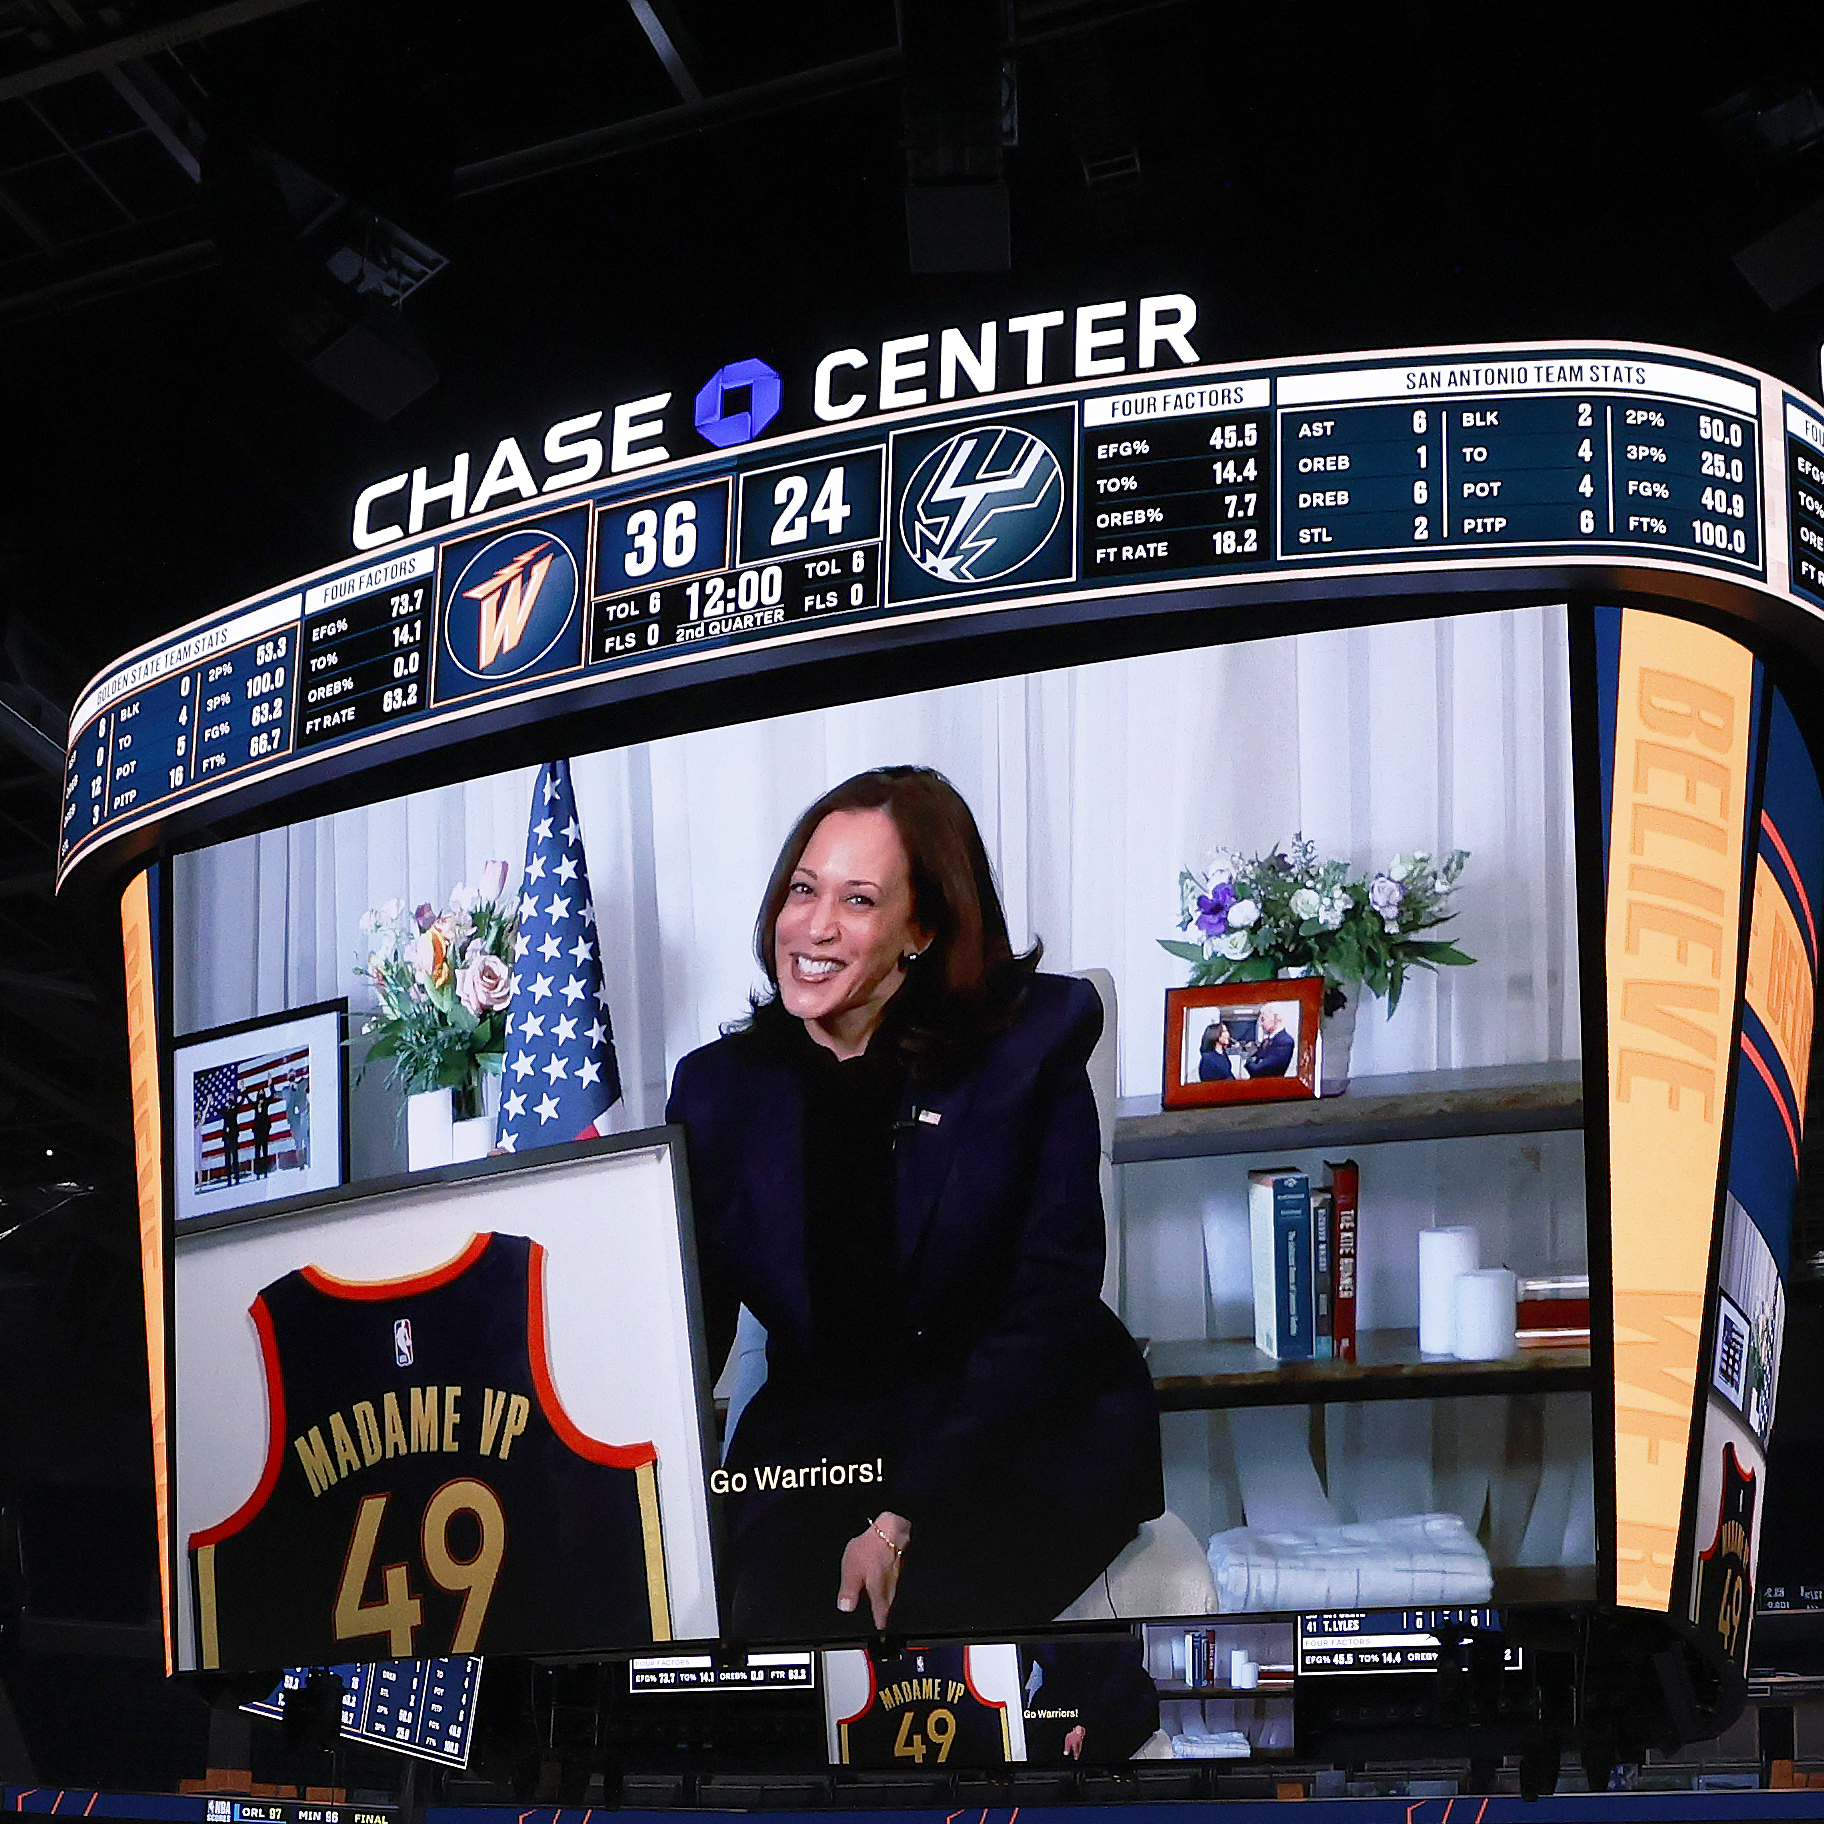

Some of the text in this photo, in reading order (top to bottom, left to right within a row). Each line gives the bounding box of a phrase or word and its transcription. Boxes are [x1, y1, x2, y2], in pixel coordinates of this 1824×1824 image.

[814, 293, 1200, 421] CENTER
[1406, 365, 1645, 390] SAN ANTONIO TEAM STATS
[1111, 387, 1244, 418] FOUR FACTORS
[1462, 403, 1592, 427] BLK 2
[1097, 424, 1257, 459] EFG% 45.5
[1299, 411, 1427, 438] AST 6
[1626, 409, 1742, 448] 2P% 50.0
[1299, 445, 1427, 473] OREB 1
[1462, 439, 1592, 462] TO 4
[1626, 445, 1743, 483] 3P% 25.0
[353, 392, 672, 551] CHASE
[1097, 458, 1257, 493] TO% 14.4
[1463, 474, 1593, 498] POT 4
[771, 467, 850, 546] 24
[1096, 493, 1257, 528] OREB% 7.7
[1299, 481, 1428, 508] DREB 6
[1628, 481, 1744, 518] FG% 40.9
[624, 501, 697, 577] 36
[1299, 517, 1428, 544] STL 2
[1463, 510, 1594, 534] PITP 6
[1629, 517, 1745, 554] FT% 100.0
[1096, 529, 1257, 563] FT RATE 18.2
[324, 558, 415, 604] FOUR FACTORS
[805, 552, 864, 579] TOL 6
[606, 593, 661, 621] TOL 6
[685, 567, 782, 620] 12:00
[804, 585, 862, 611] FLS 0
[312, 590, 423, 641] EFG% 73.7
[676, 608, 784, 642] 2nd QUARTER
[310, 621, 420, 671] TO% 14.1
[605, 625, 659, 654] FLS 0
[97, 629, 227, 705] GOLDEN STATE TEAM STATS
[208, 637, 286, 682] 2P% 53.3
[308, 653, 419, 702] OREB% 0.0
[206, 669, 284, 712] 3P% 100.0
[306, 684, 417, 734] FT RATE 63.2
[204, 699, 282, 741] FG% 63.2
[202, 729, 280, 772] FT% 66.7
[1615, 666, 1736, 1124] BELIEVE
[294, 1385, 530, 1497] MADAME VP
[709, 1458, 884, 1493] Go Warriors!
[333, 1477, 508, 1657] 49
